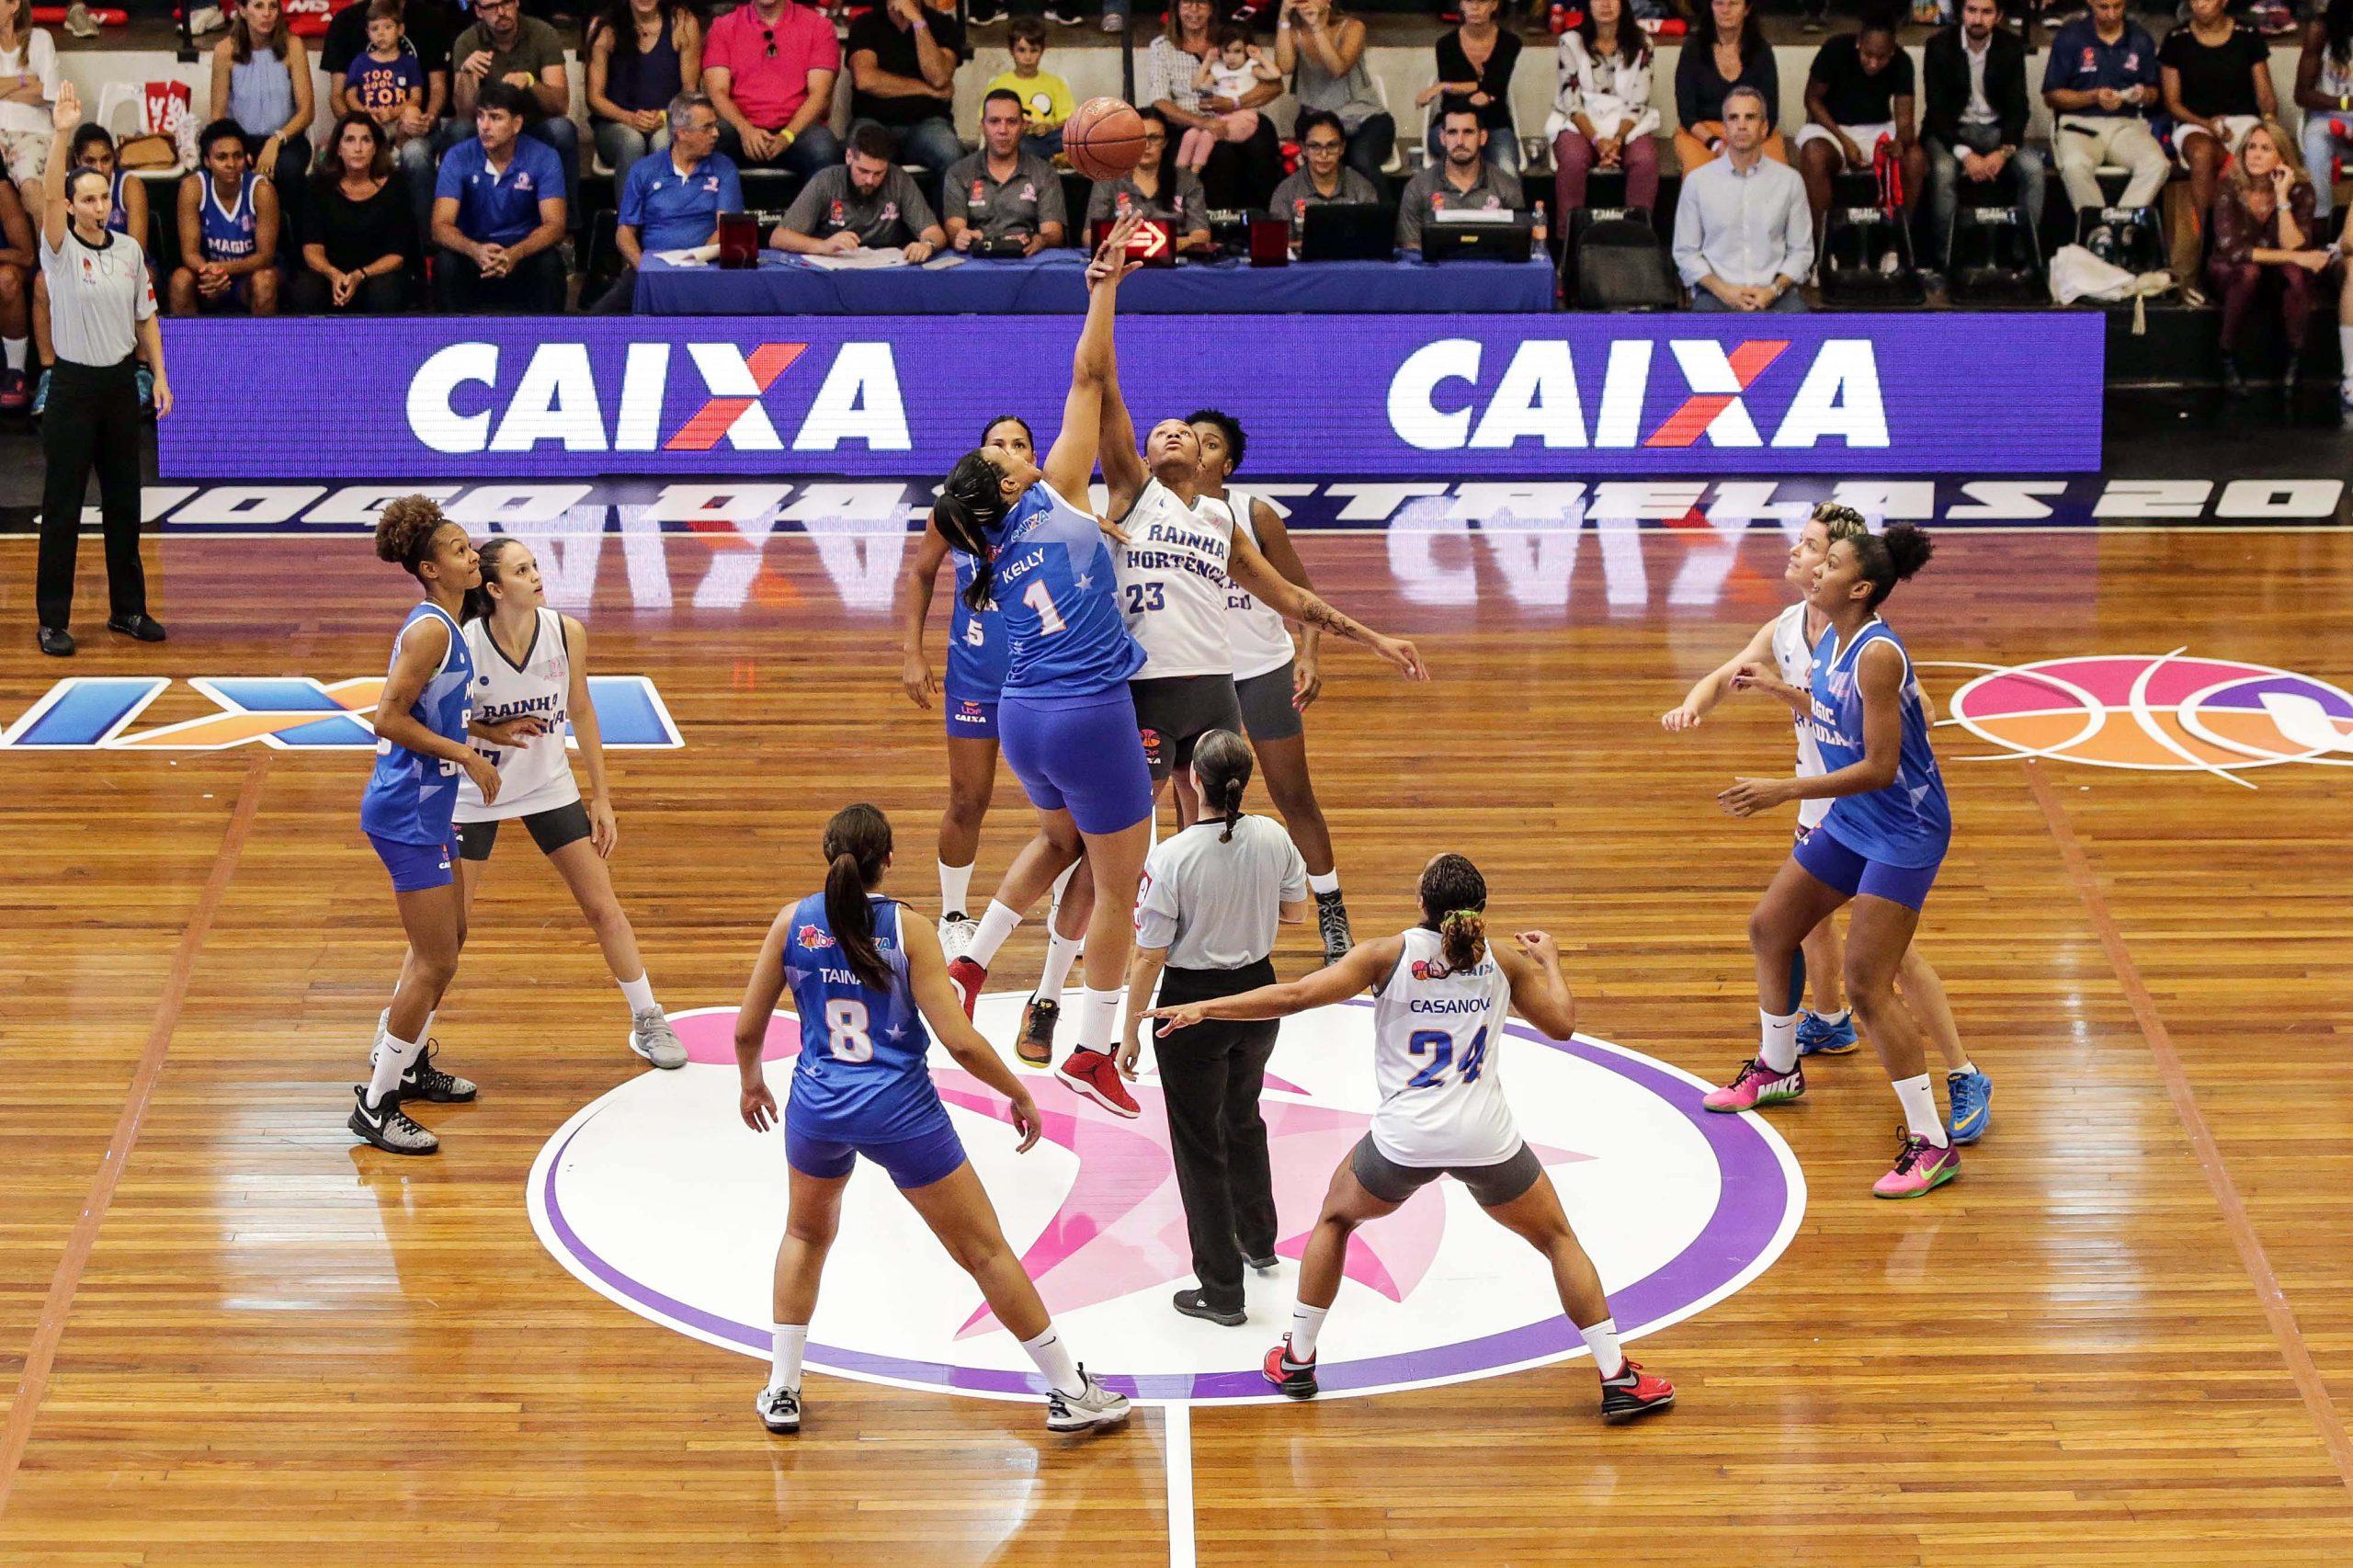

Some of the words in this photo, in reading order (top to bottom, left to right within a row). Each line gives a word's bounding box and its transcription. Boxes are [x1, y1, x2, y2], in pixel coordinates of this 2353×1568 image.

[363, 69, 393, 82] TOO
[208, 237, 255, 254] MAGIC
[406, 341, 914, 453] CAIXA
[1386, 337, 1892, 450] CAIXA
[1147, 524, 1225, 561] RAINHA
[1002, 547, 1045, 585] KELLY
[1022, 579, 1068, 637] 1
[1126, 582, 1165, 614] 23
[967, 618, 985, 647] 5
[954, 714, 986, 723] CAIXA
[824, 997, 874, 1063] 8
[1405, 1024, 1489, 1089] 24
[1756, 1072, 1801, 1100] NIKE
